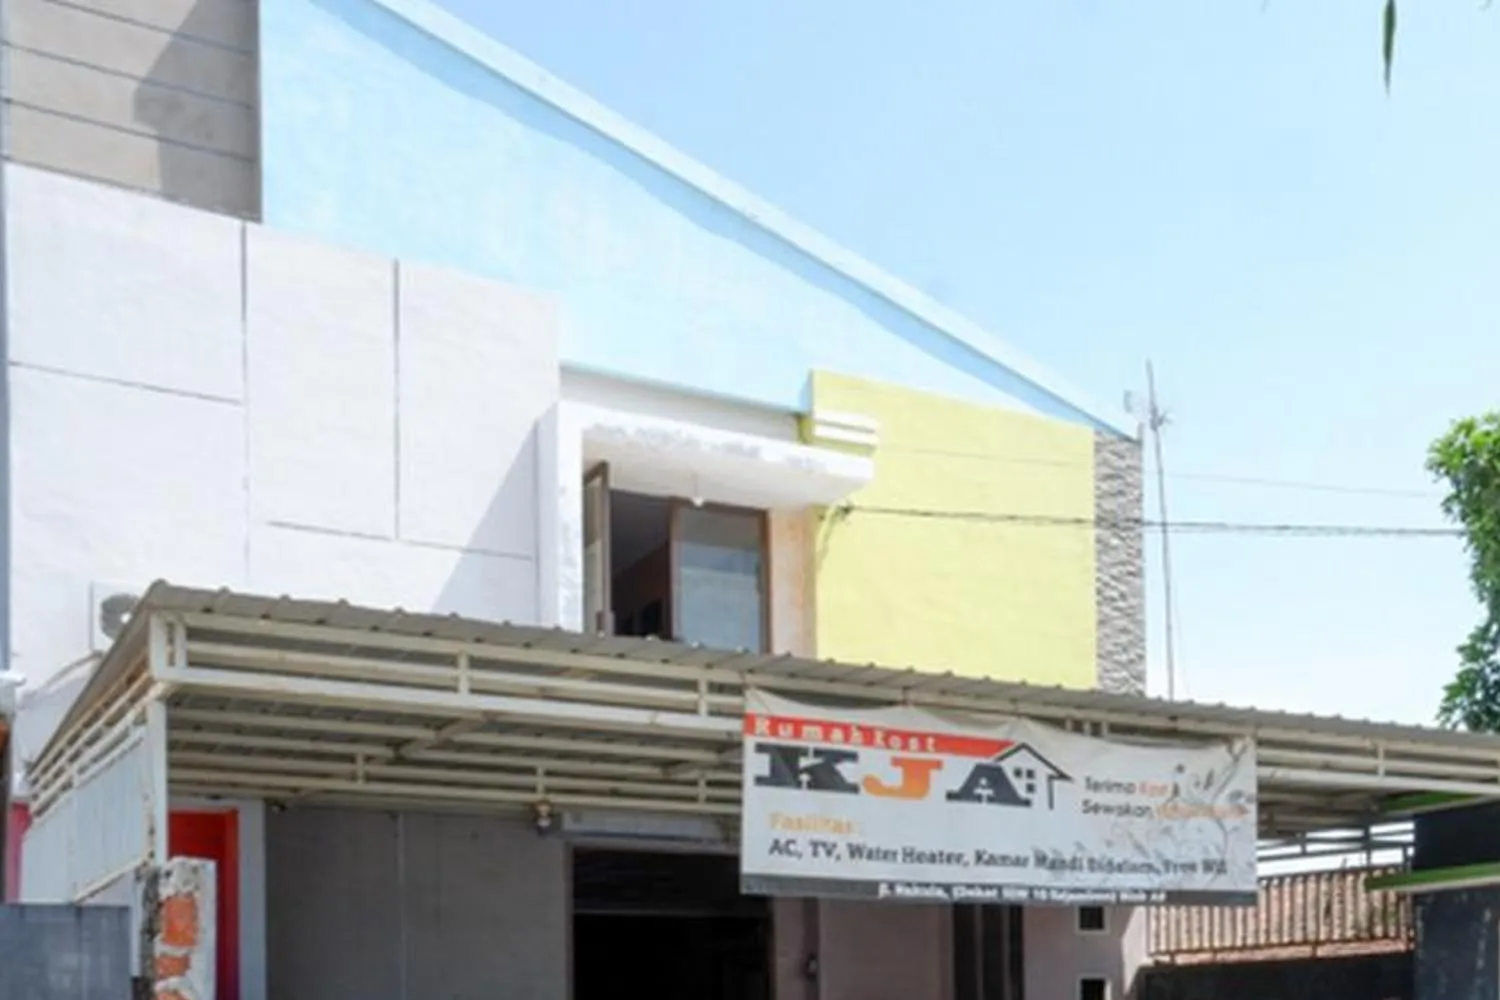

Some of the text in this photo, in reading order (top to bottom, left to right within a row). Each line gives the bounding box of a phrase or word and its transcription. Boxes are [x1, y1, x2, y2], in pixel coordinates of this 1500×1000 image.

[754, 743, 1032, 807] KJA
[768, 838, 803, 861] AC,
[809, 840, 841, 862] TV,
[846, 843, 899, 863] Water
